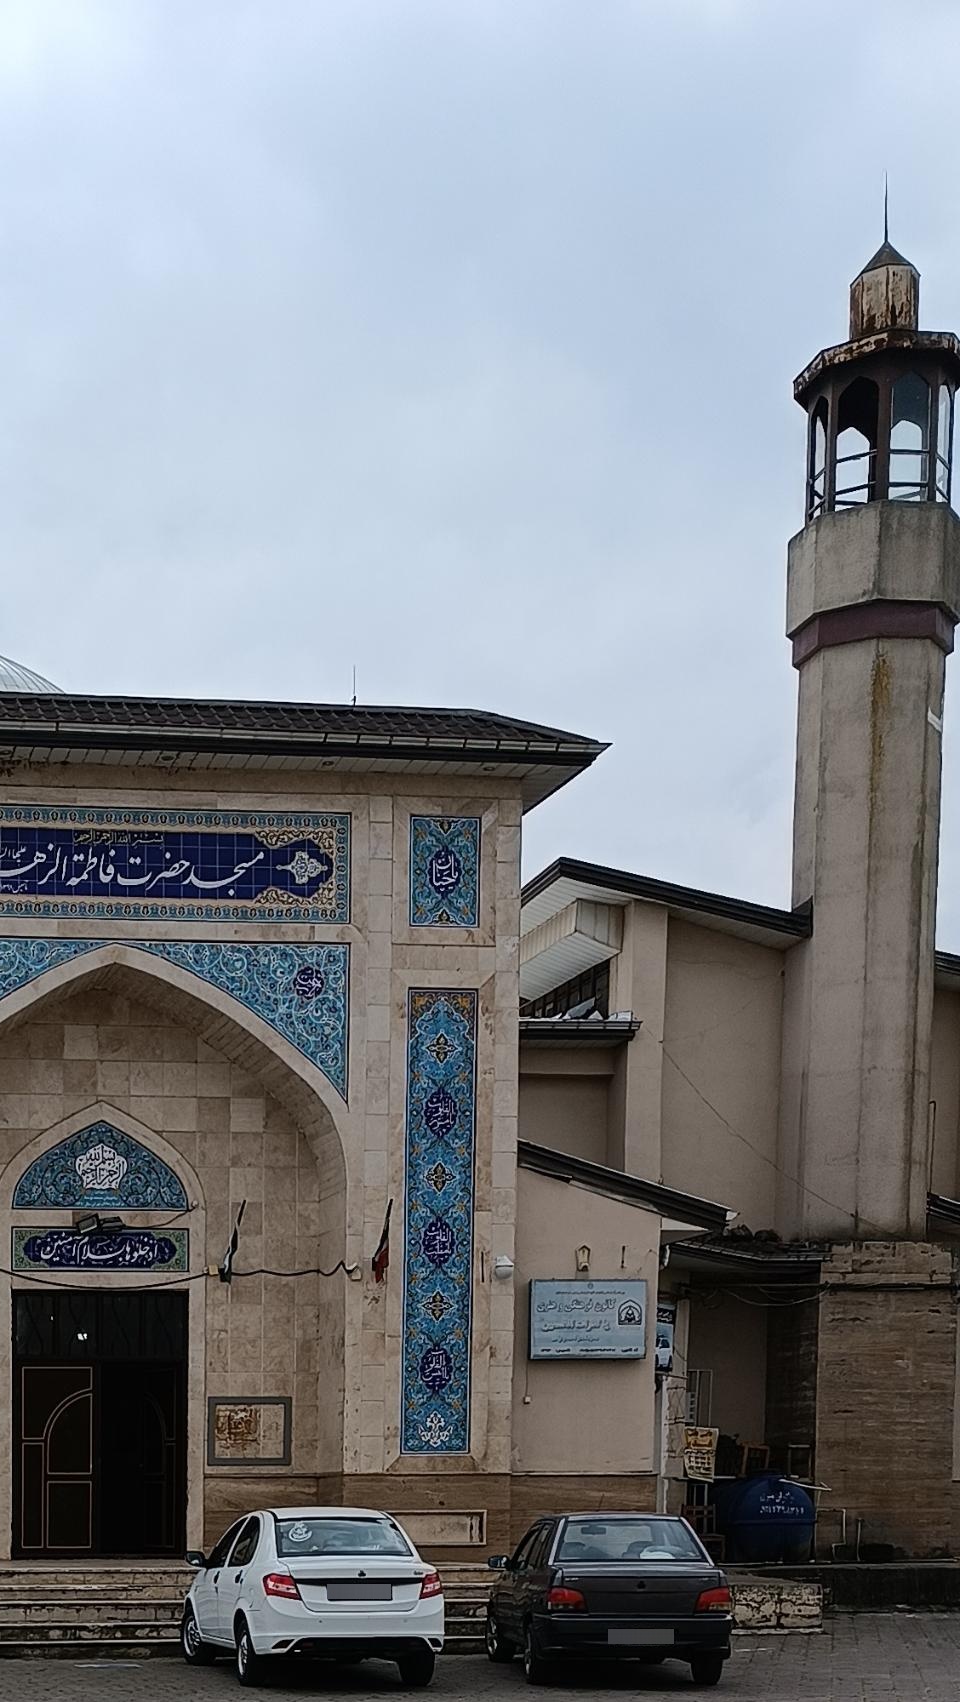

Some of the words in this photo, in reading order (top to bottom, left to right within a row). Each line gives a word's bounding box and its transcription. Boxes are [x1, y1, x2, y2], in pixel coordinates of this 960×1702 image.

[117, 832, 131, 844] الله
[117, 851, 190, 891] حضرت
[182, 850, 265, 896] مسجد
[77, 1235, 126, 1264] بسلام
[126, 1235, 158, 1263] ادخلوها
